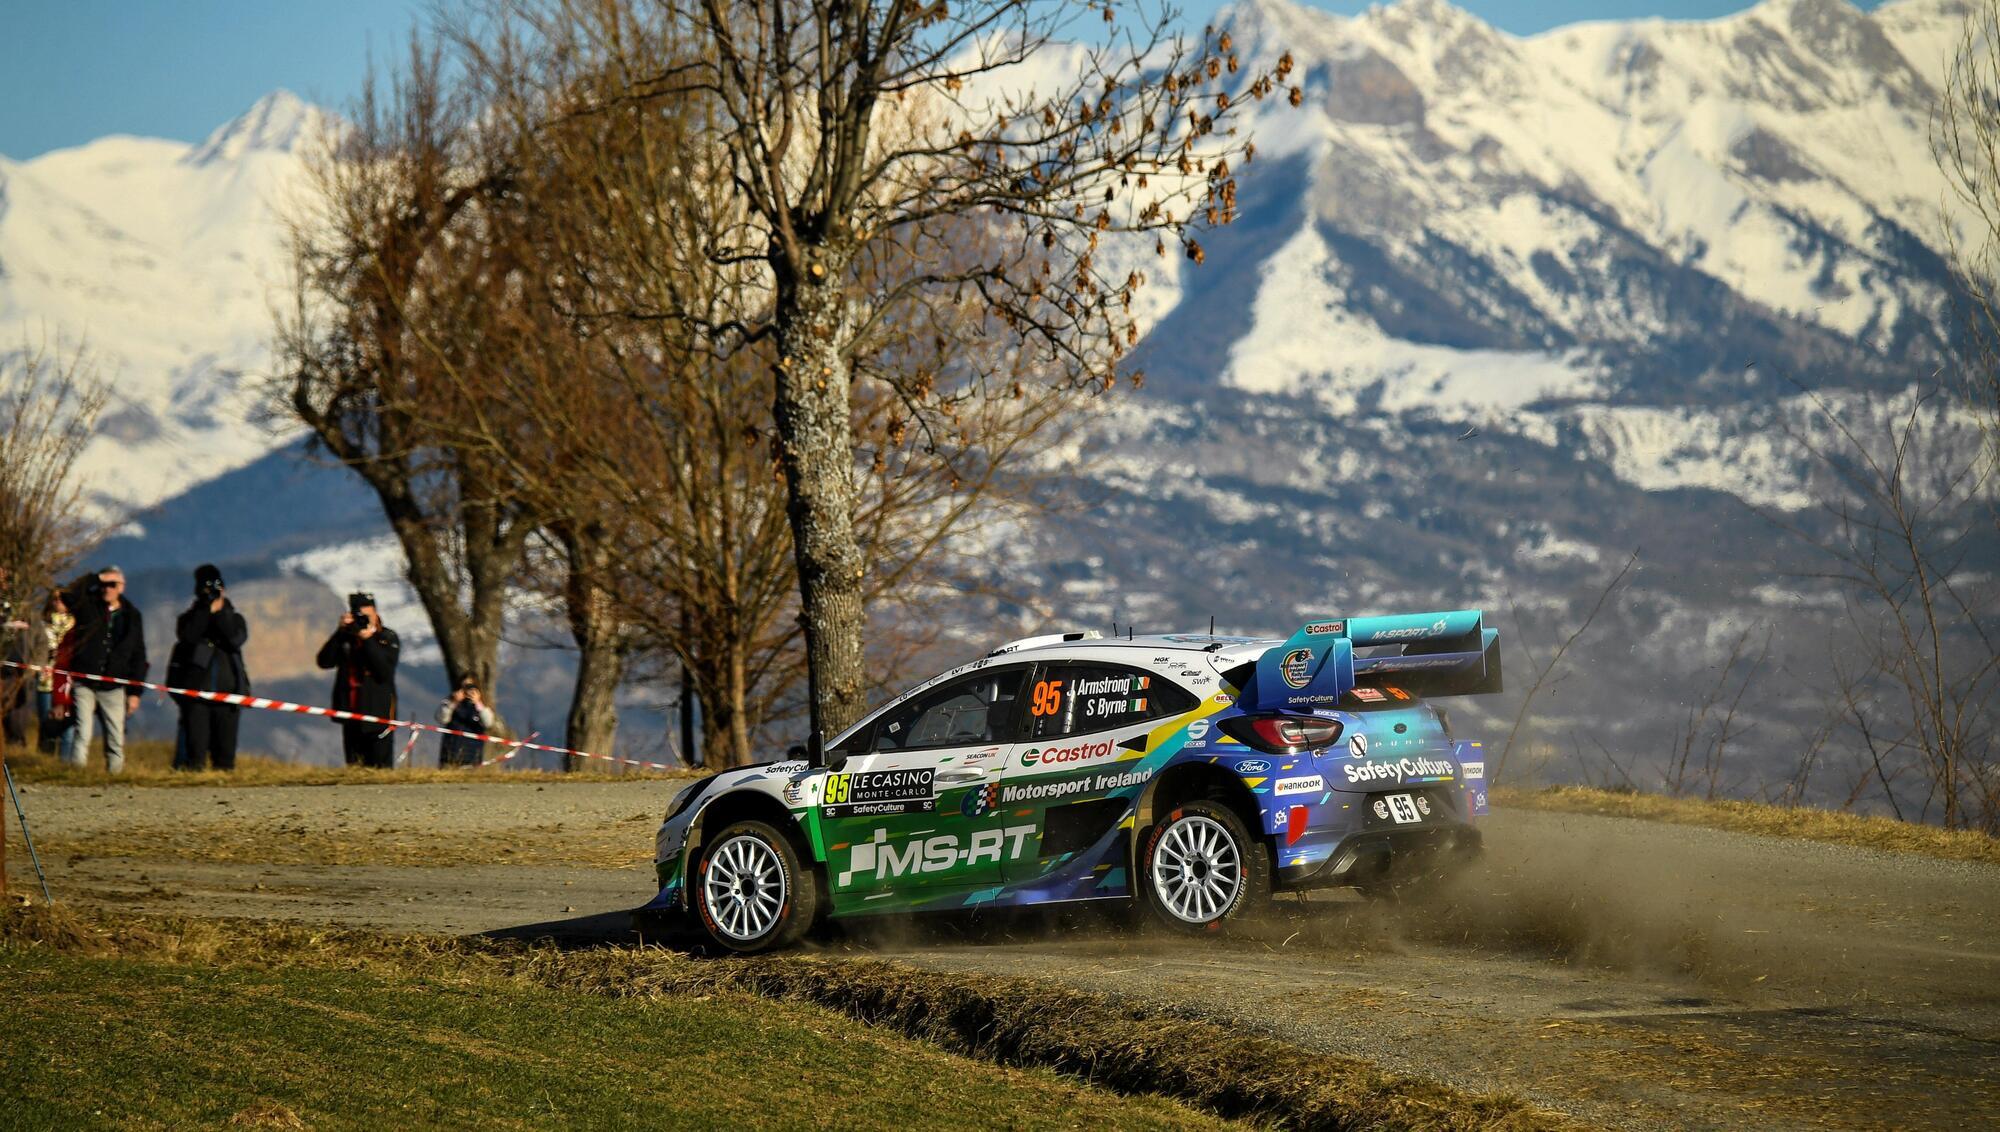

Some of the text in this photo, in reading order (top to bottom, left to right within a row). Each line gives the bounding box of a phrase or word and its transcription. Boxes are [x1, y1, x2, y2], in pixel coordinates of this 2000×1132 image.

[1313, 624, 1342, 634] Castrol
[1372, 628, 1430, 640] M-SPORT
[1066, 677, 1130, 696] J Armstrong
[1031, 680, 1062, 716] 95
[1288, 694, 1334, 704] SafetyCulture
[1086, 698, 1127, 718] S Byrne
[1042, 738, 1114, 764] Castrol
[1240, 762, 1264, 772] Ford
[1344, 757, 1454, 784] SafetyCulture
[854, 770, 932, 788] LE CASINO
[1002, 768, 1152, 802] Motorsport Ireland
[826, 774, 850, 804] 95
[826, 808, 836, 816] SC
[853, 804, 905, 814] SafetyCulture
[923, 801, 932, 809] SC
[1393, 796, 1415, 820] 95
